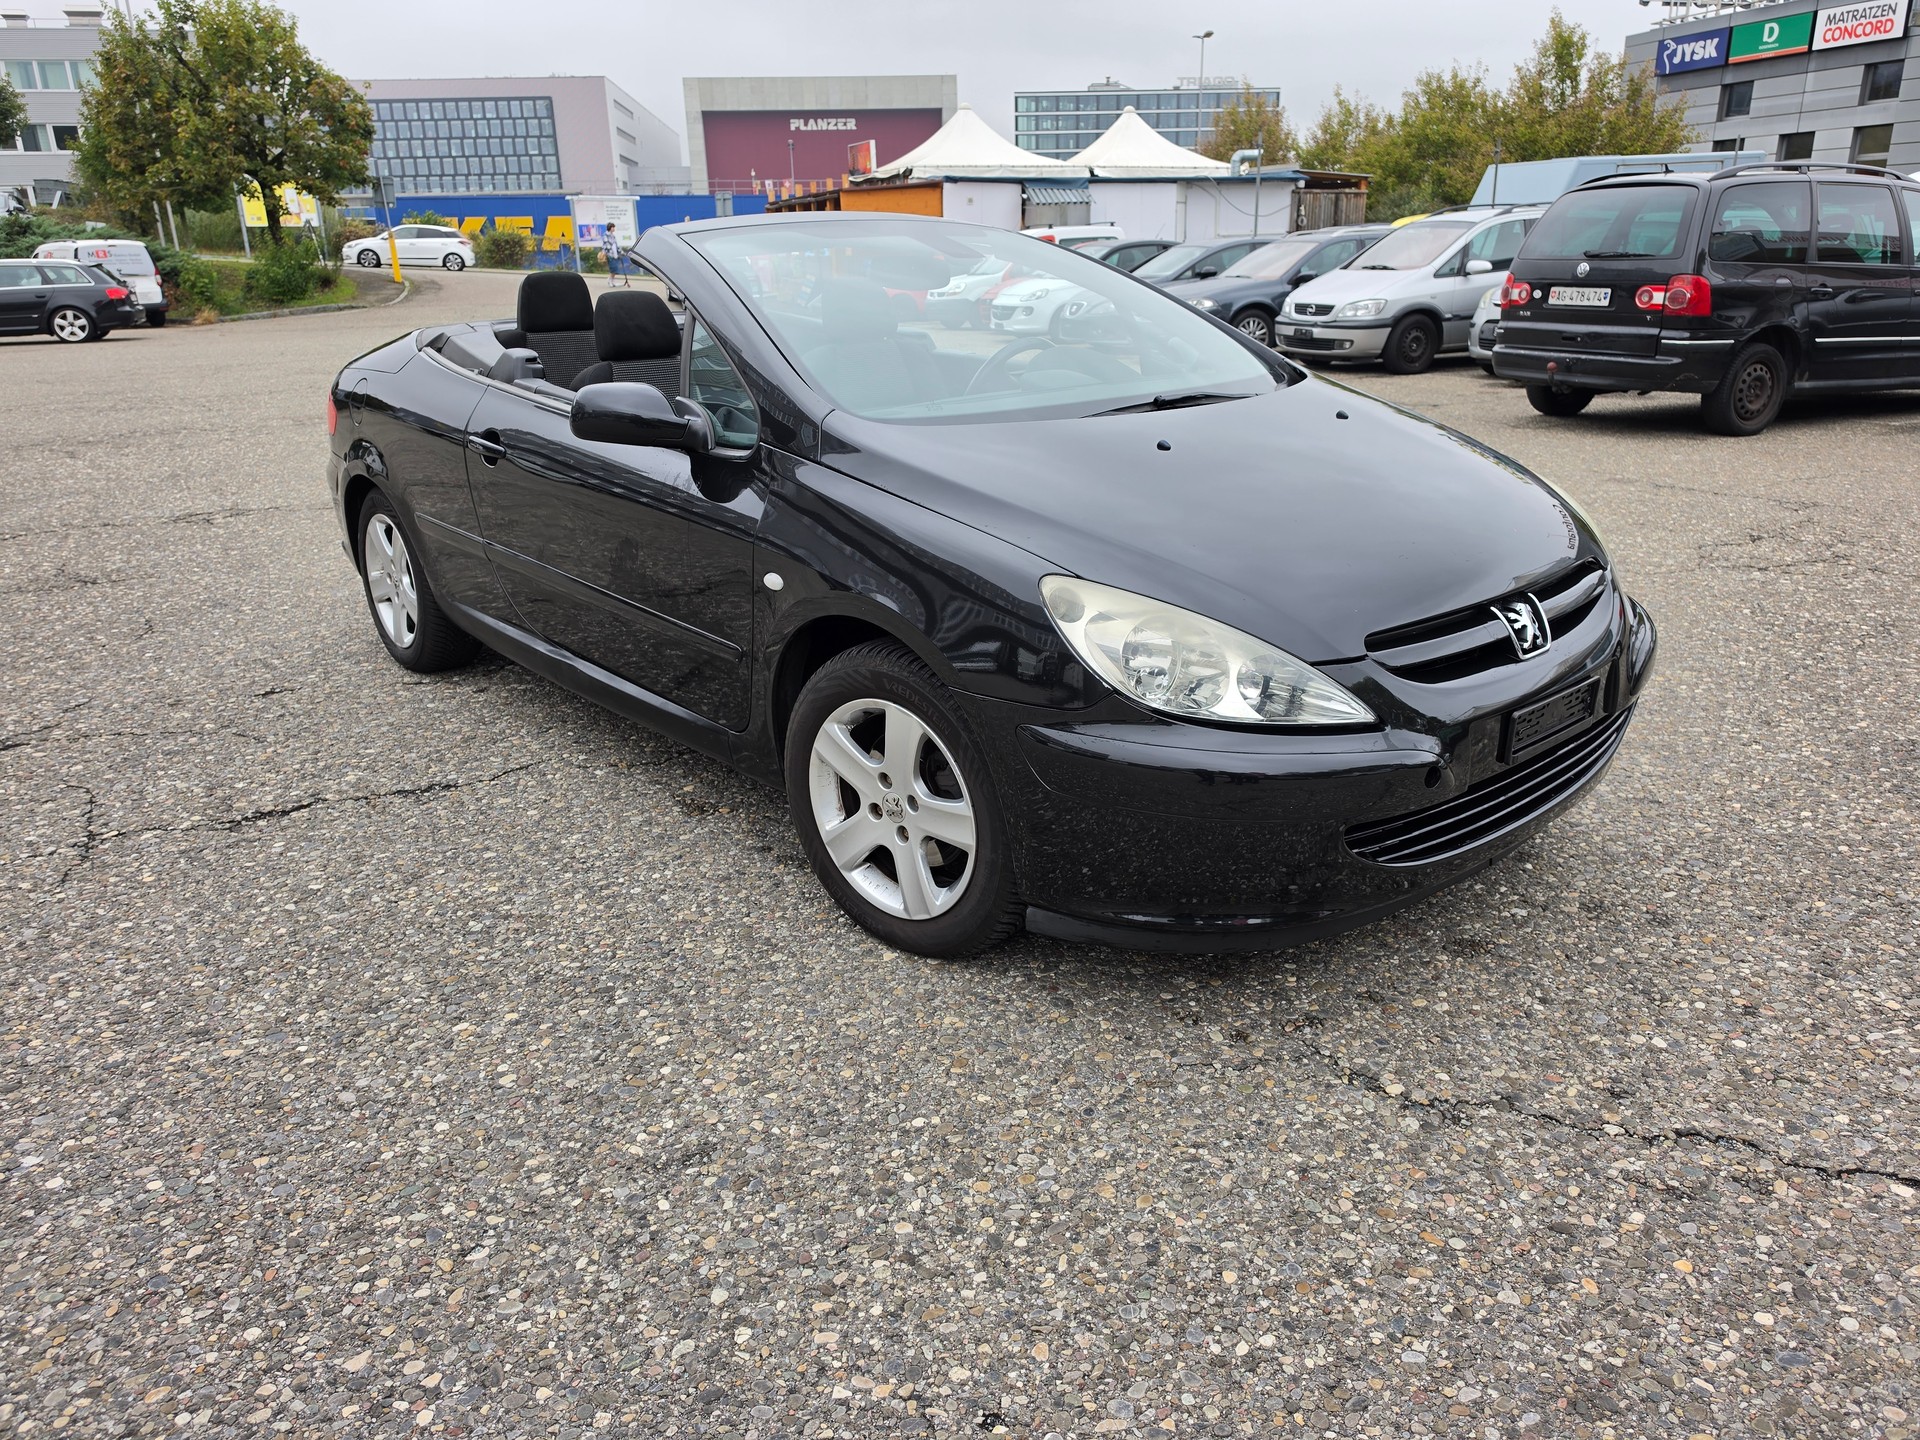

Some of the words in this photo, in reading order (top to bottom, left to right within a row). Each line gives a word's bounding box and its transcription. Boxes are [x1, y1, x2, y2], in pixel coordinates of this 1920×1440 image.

[1825, 3, 1898, 26] MATRATZEN
[1823, 18, 1894, 43] CONCORD
[1672, 38, 1719, 64] JYSK
[790, 119, 857, 131] PLANZER
